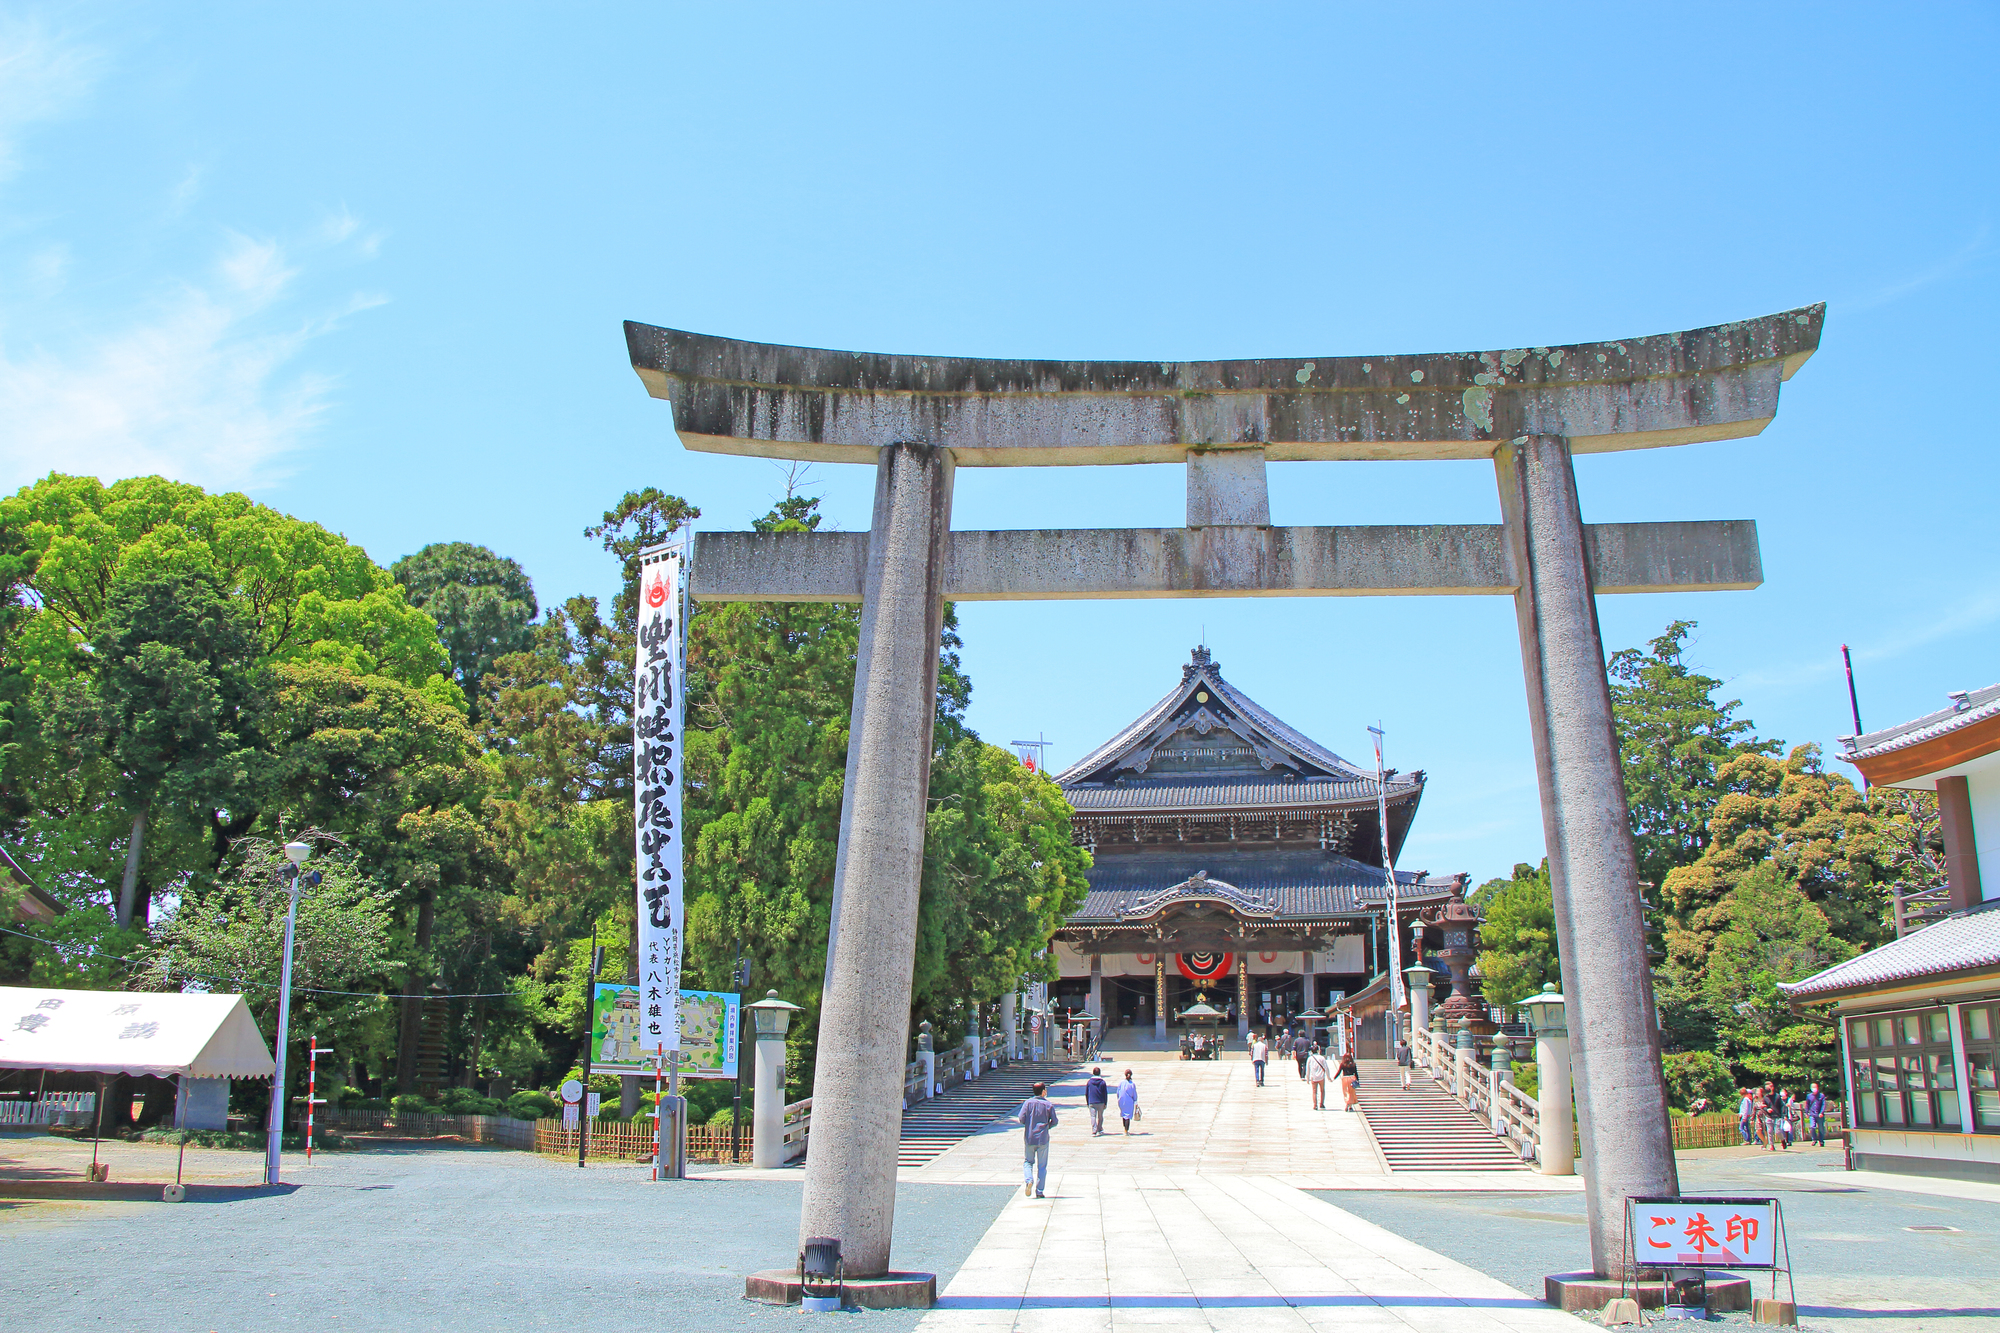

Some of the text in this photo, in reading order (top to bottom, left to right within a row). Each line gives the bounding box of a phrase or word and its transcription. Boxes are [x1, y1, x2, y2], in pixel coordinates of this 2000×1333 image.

[647, 941, 662, 1035] 代表 八木雄也
[1648, 1212, 1759, 1254] ご朱印
